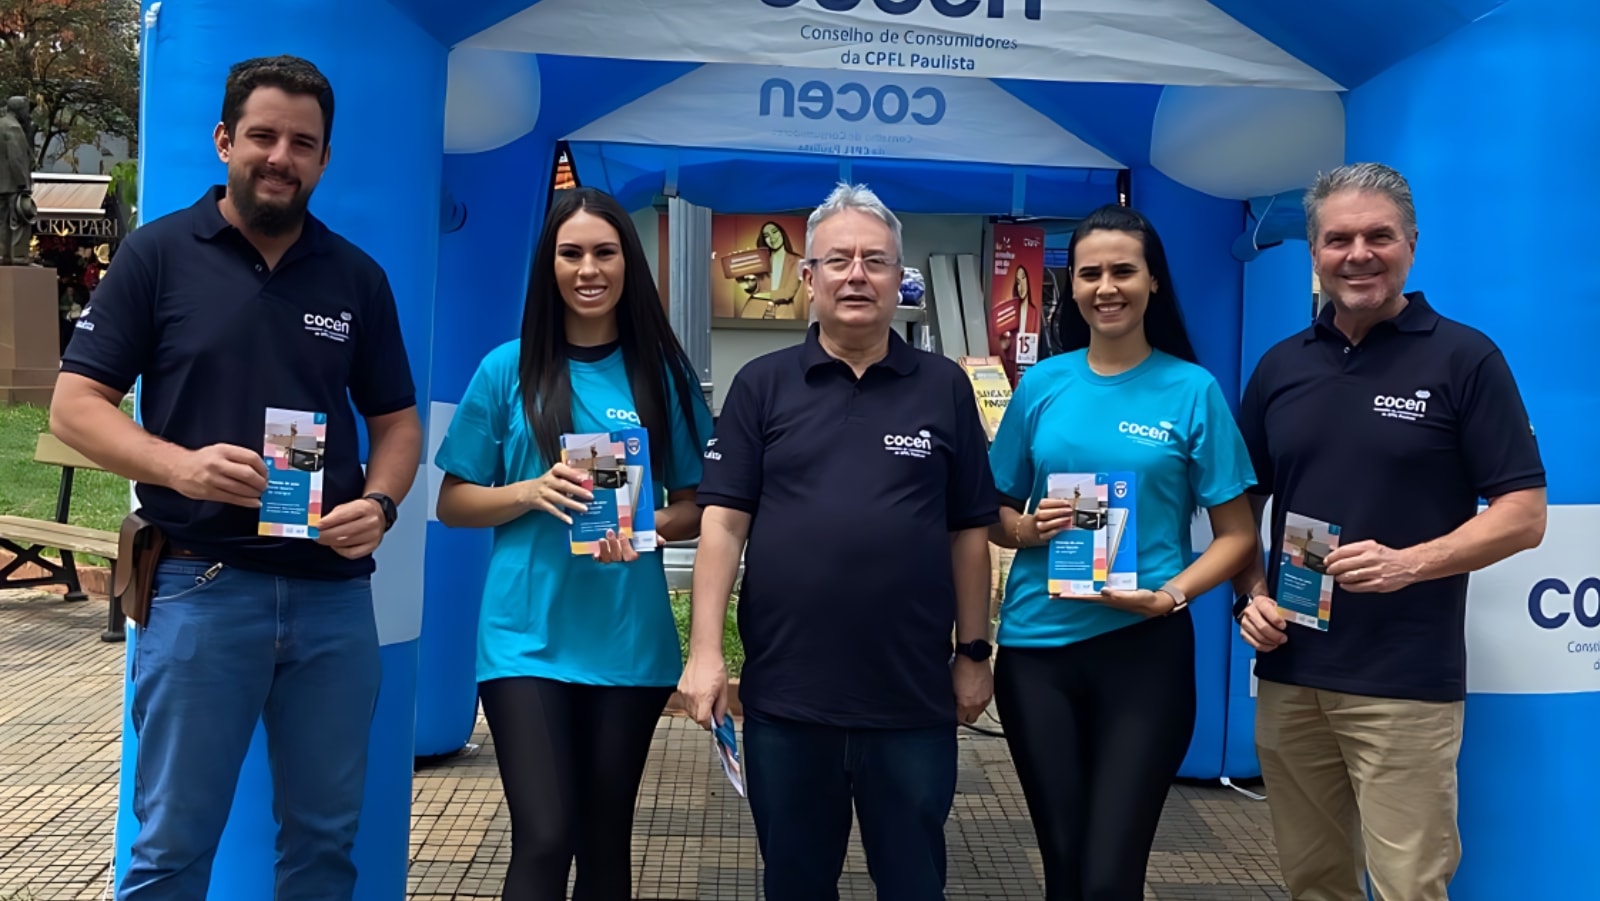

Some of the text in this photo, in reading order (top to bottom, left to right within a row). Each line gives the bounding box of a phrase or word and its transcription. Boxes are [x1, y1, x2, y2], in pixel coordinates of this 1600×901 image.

[800, 24, 1018, 50] Conselho de Consumidores
[840, 50, 975, 71] da CPFL Paulista
[304, 313, 349, 335] cocen
[1374, 395, 1427, 413] cocen
[884, 434, 932, 450] cocen
[1118, 420, 1169, 443] cocen
